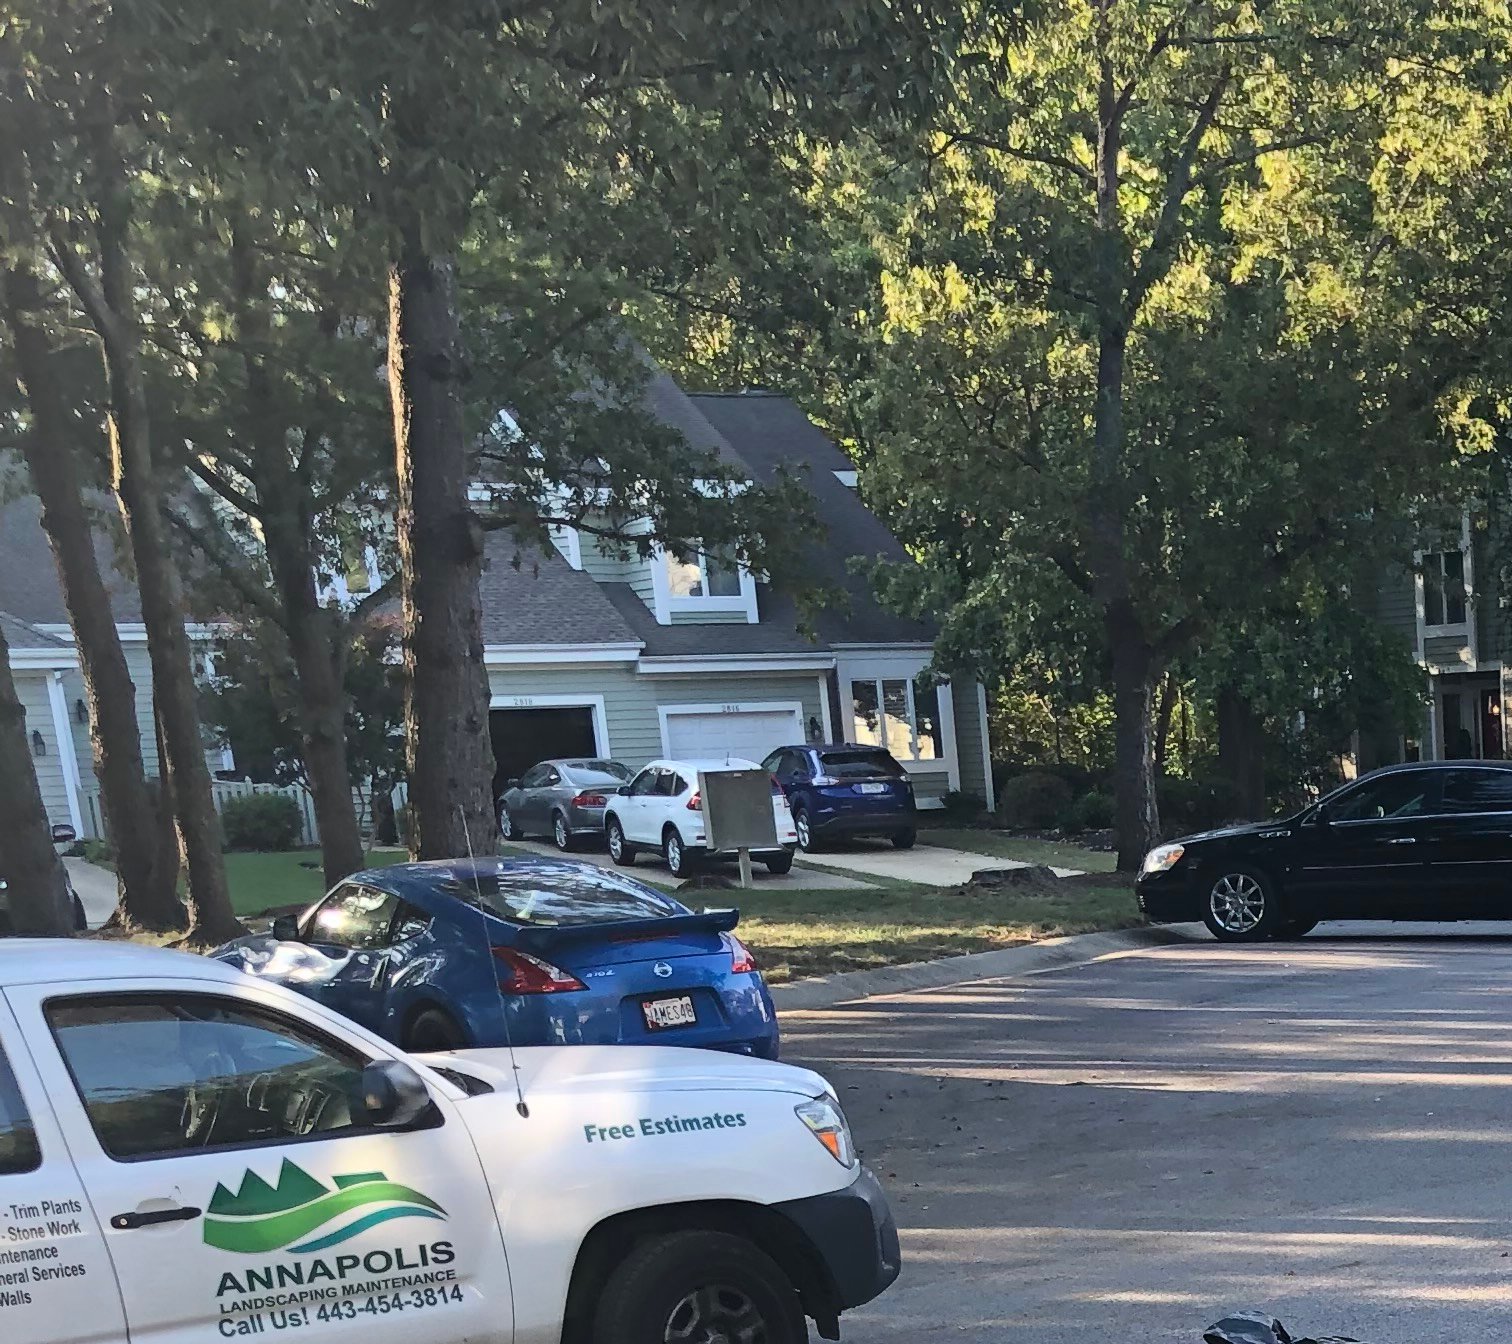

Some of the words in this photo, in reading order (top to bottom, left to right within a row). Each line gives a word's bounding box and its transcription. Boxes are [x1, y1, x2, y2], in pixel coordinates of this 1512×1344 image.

[583, 1124, 635, 1143] Free
[638, 1112, 747, 1137] Estimates
[10, 1203, 39, 1219] Trim
[41, 1199, 82, 1217] Plants
[8, 1225, 46, 1242] Stone
[46, 1218, 82, 1237] Work
[0, 1246, 59, 1265] ntenance
[215, 1240, 456, 1298] ANNAPOLIS
[31, 1262, 86, 1282] Services
[220, 1287, 338, 1315] LANDSCAPING
[341, 1269, 457, 1297] MAINTENANCE
[218, 1313, 265, 1338] Call
[269, 1306, 310, 1330] Us!
[316, 1283, 464, 1323] 443-454-3814
